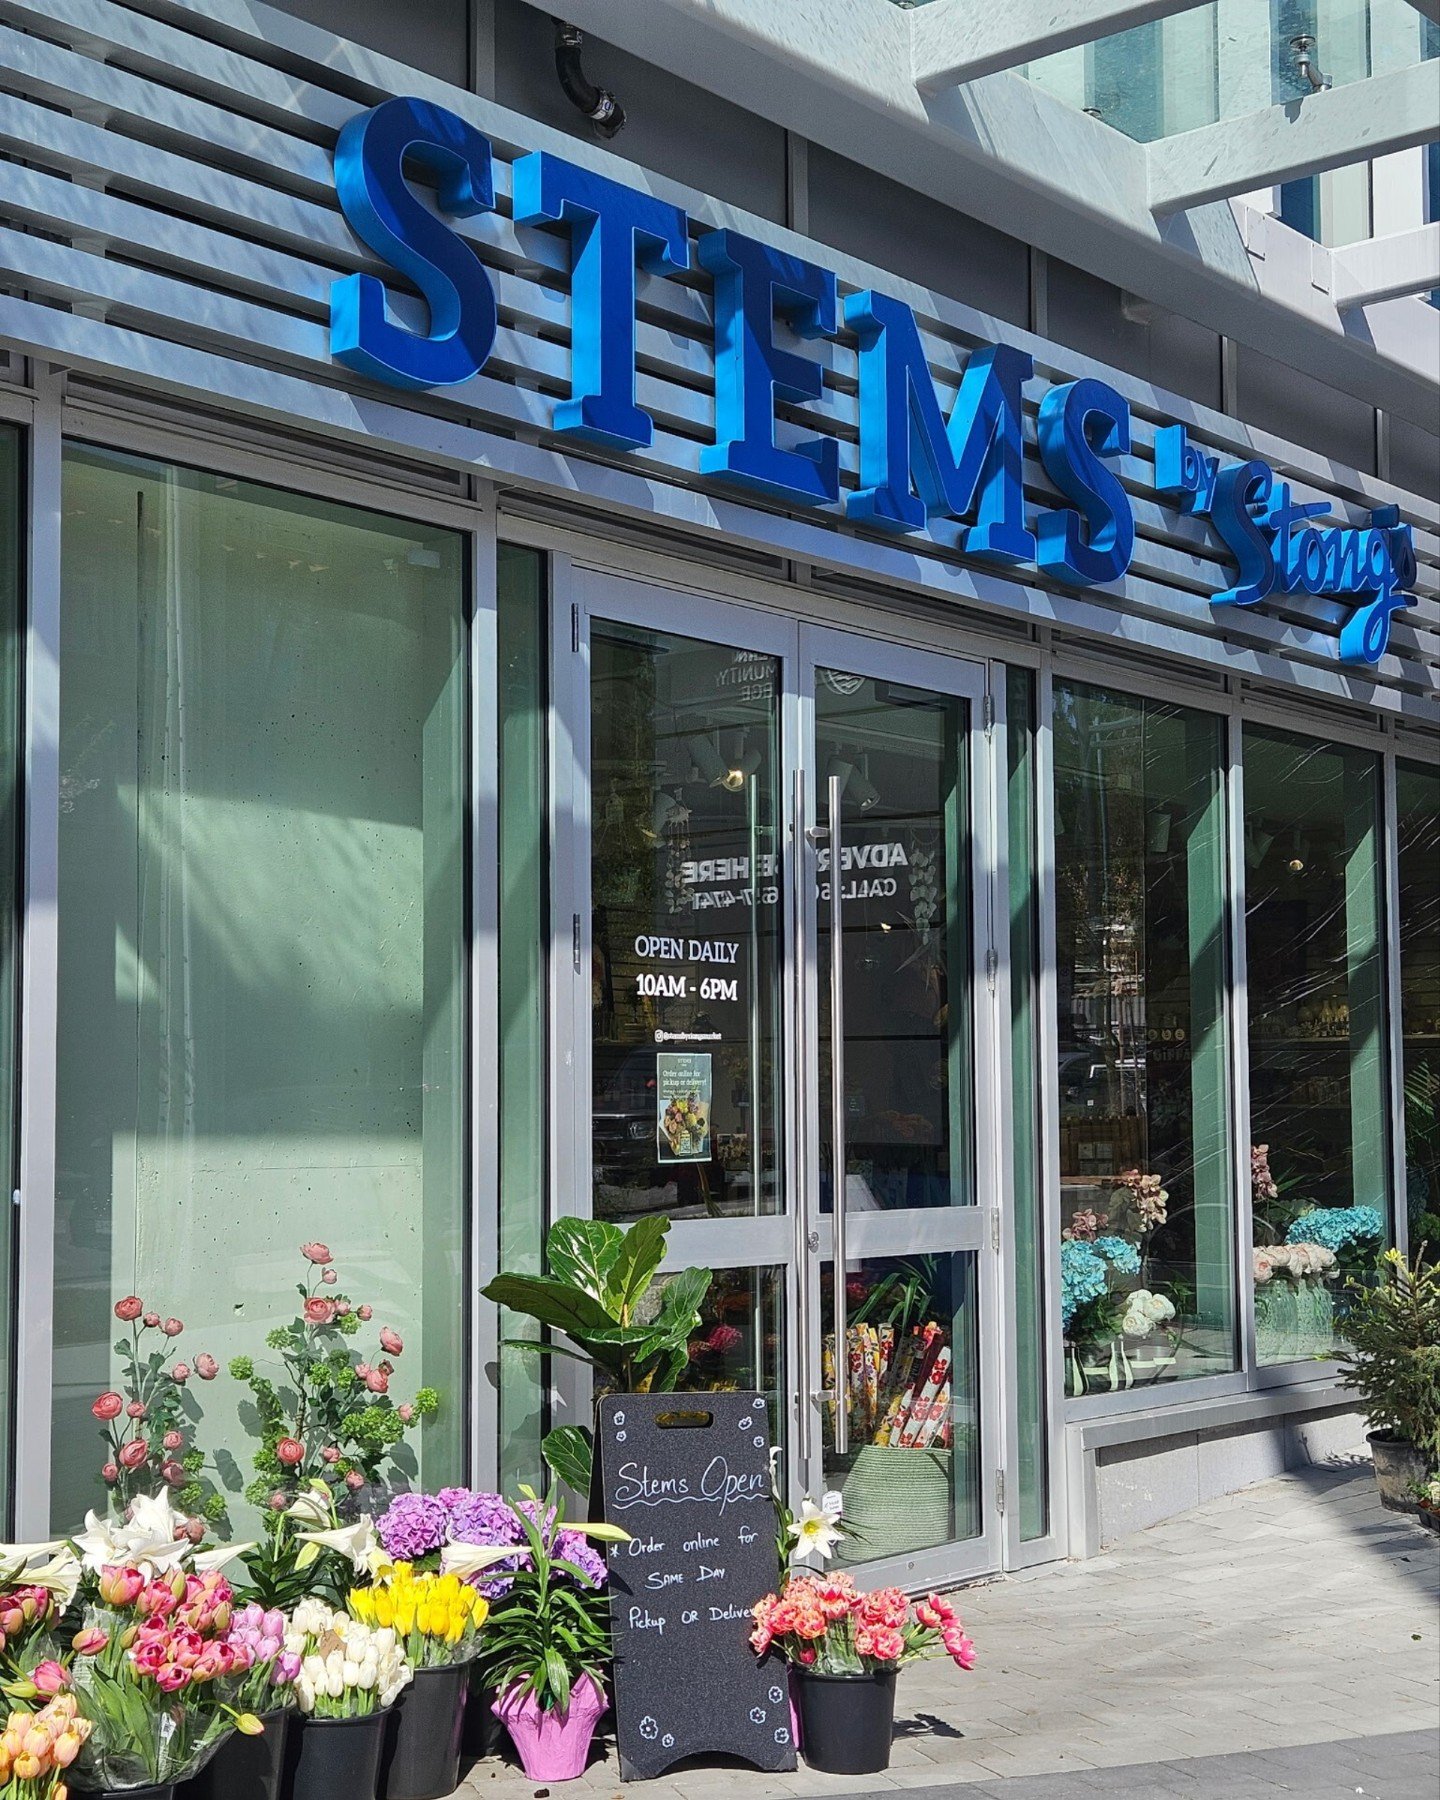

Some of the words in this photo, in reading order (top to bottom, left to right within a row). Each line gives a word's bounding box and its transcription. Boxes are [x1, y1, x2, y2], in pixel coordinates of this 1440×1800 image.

[331, 95, 1135, 586] STEMS
[1154, 424, 1220, 516] by
[635, 935, 684, 960] OPEN
[688, 939, 739, 963] DAILY
[636, 973, 686, 998] 10AM
[700, 977, 738, 1001] 6PM
[662, 1078, 680, 1087] pickup
[615, 1462, 689, 1501] Stems
[701, 1456, 764, 1516] Open
[628, 1537, 666, 1556] Order
[683, 1532, 720, 1552] online
[738, 1526, 758, 1544] for
[629, 1606, 666, 1635] Pickup
[682, 1610, 700, 1625] OR
